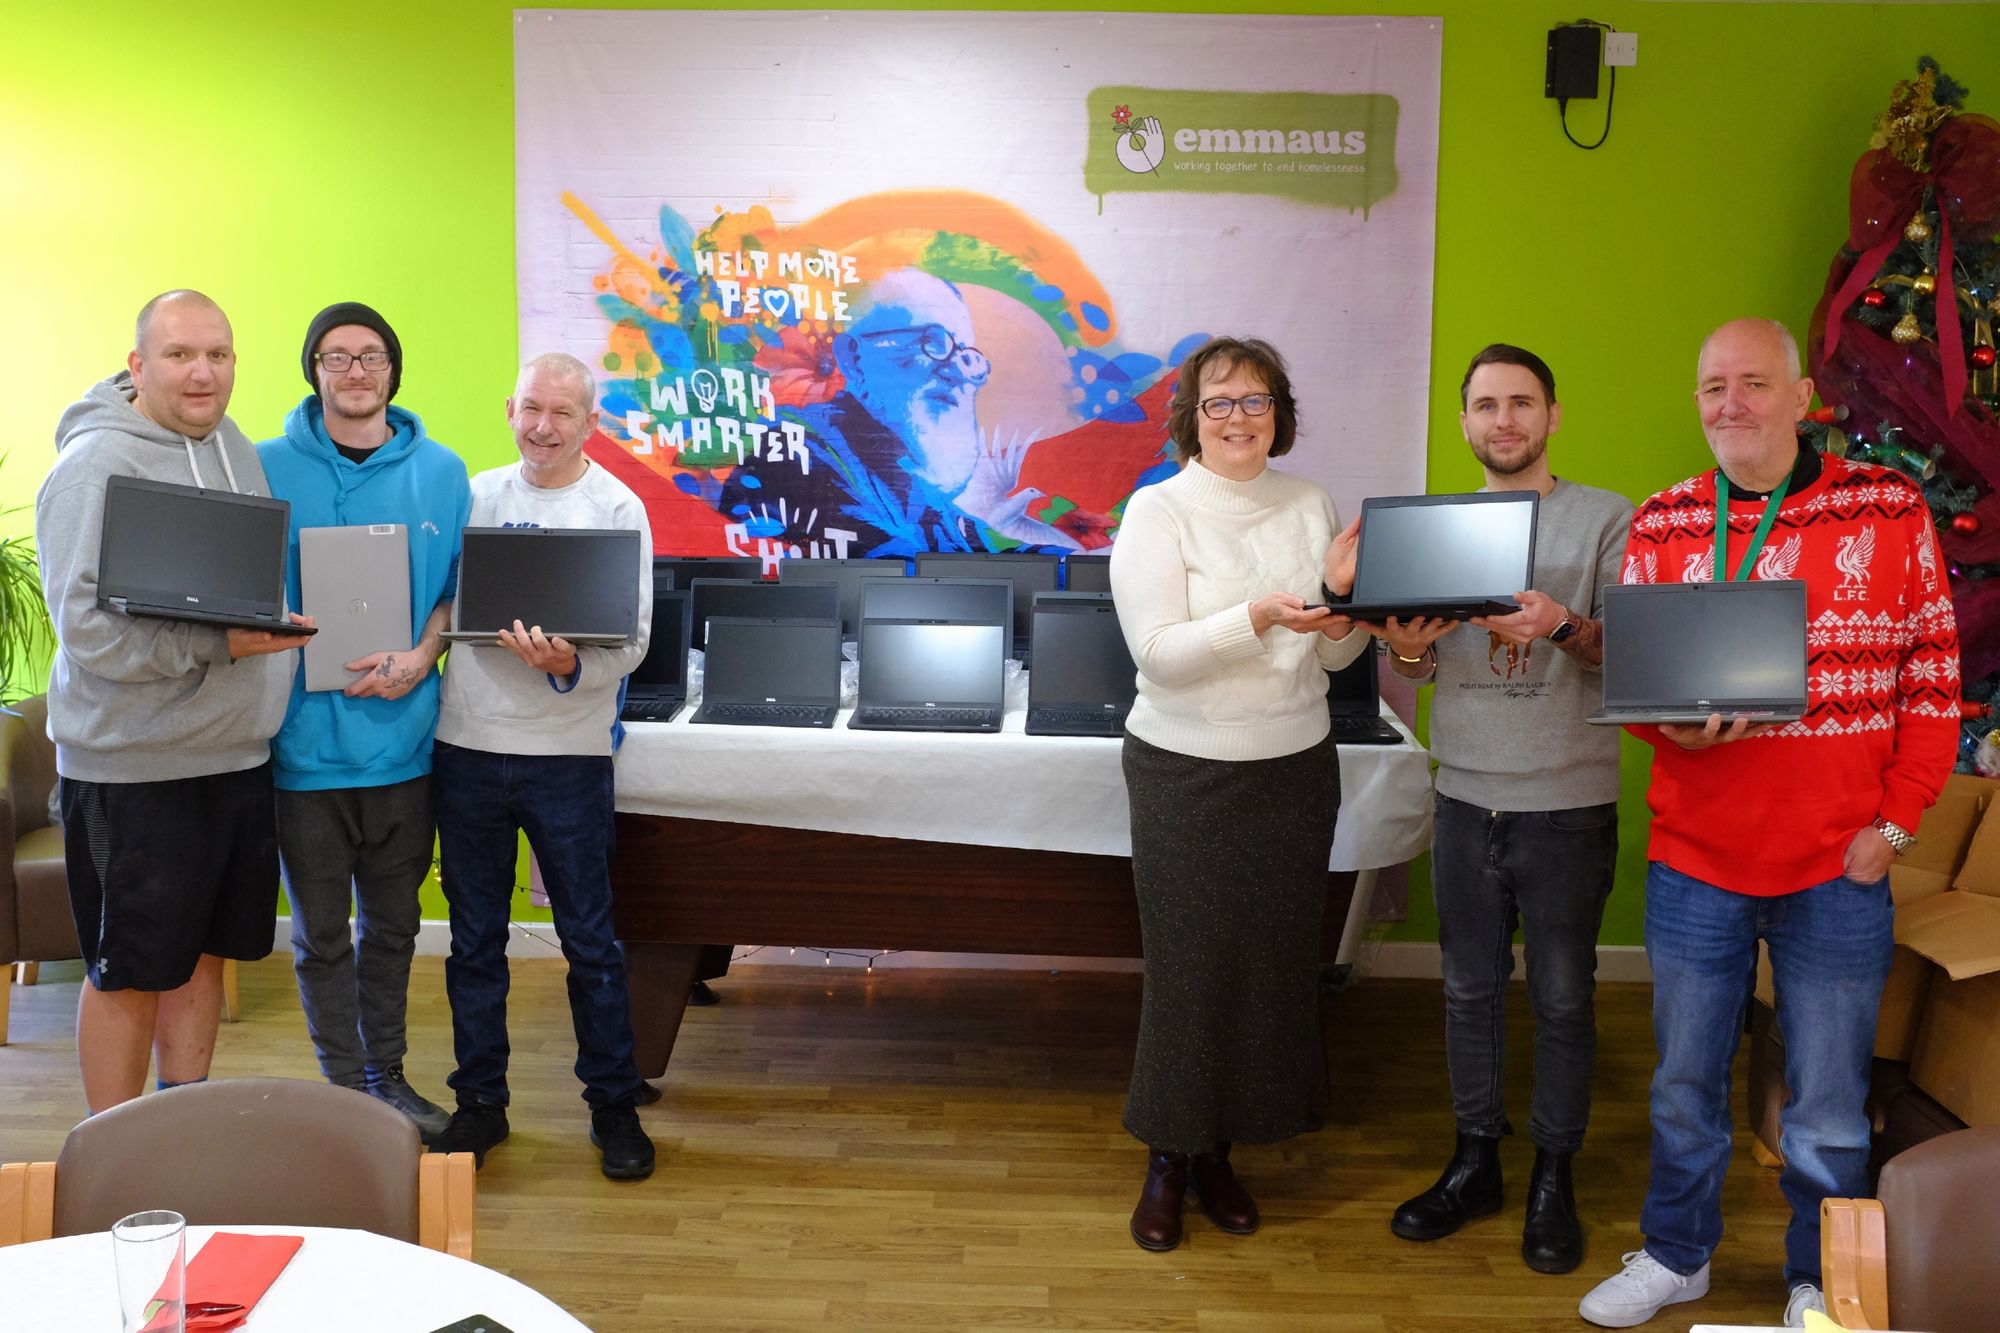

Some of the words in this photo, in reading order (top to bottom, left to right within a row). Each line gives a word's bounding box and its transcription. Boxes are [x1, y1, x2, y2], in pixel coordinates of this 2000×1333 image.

[1174, 128, 1366, 155] emmaus
[1174, 161, 1211, 173] working
[1215, 161, 1257, 173] together
[1263, 162, 1273, 172] to
[1277, 161, 1295, 172] end
[1299, 162, 1365, 173] homelessness
[694, 250, 769, 280] HELP
[778, 248, 860, 288] MORE
[716, 279, 852, 321] PEOPLE
[650, 367, 776, 422] WORK
[625, 409, 809, 475] SMARTER
[1833, 590, 1870, 601] L.F.C.
